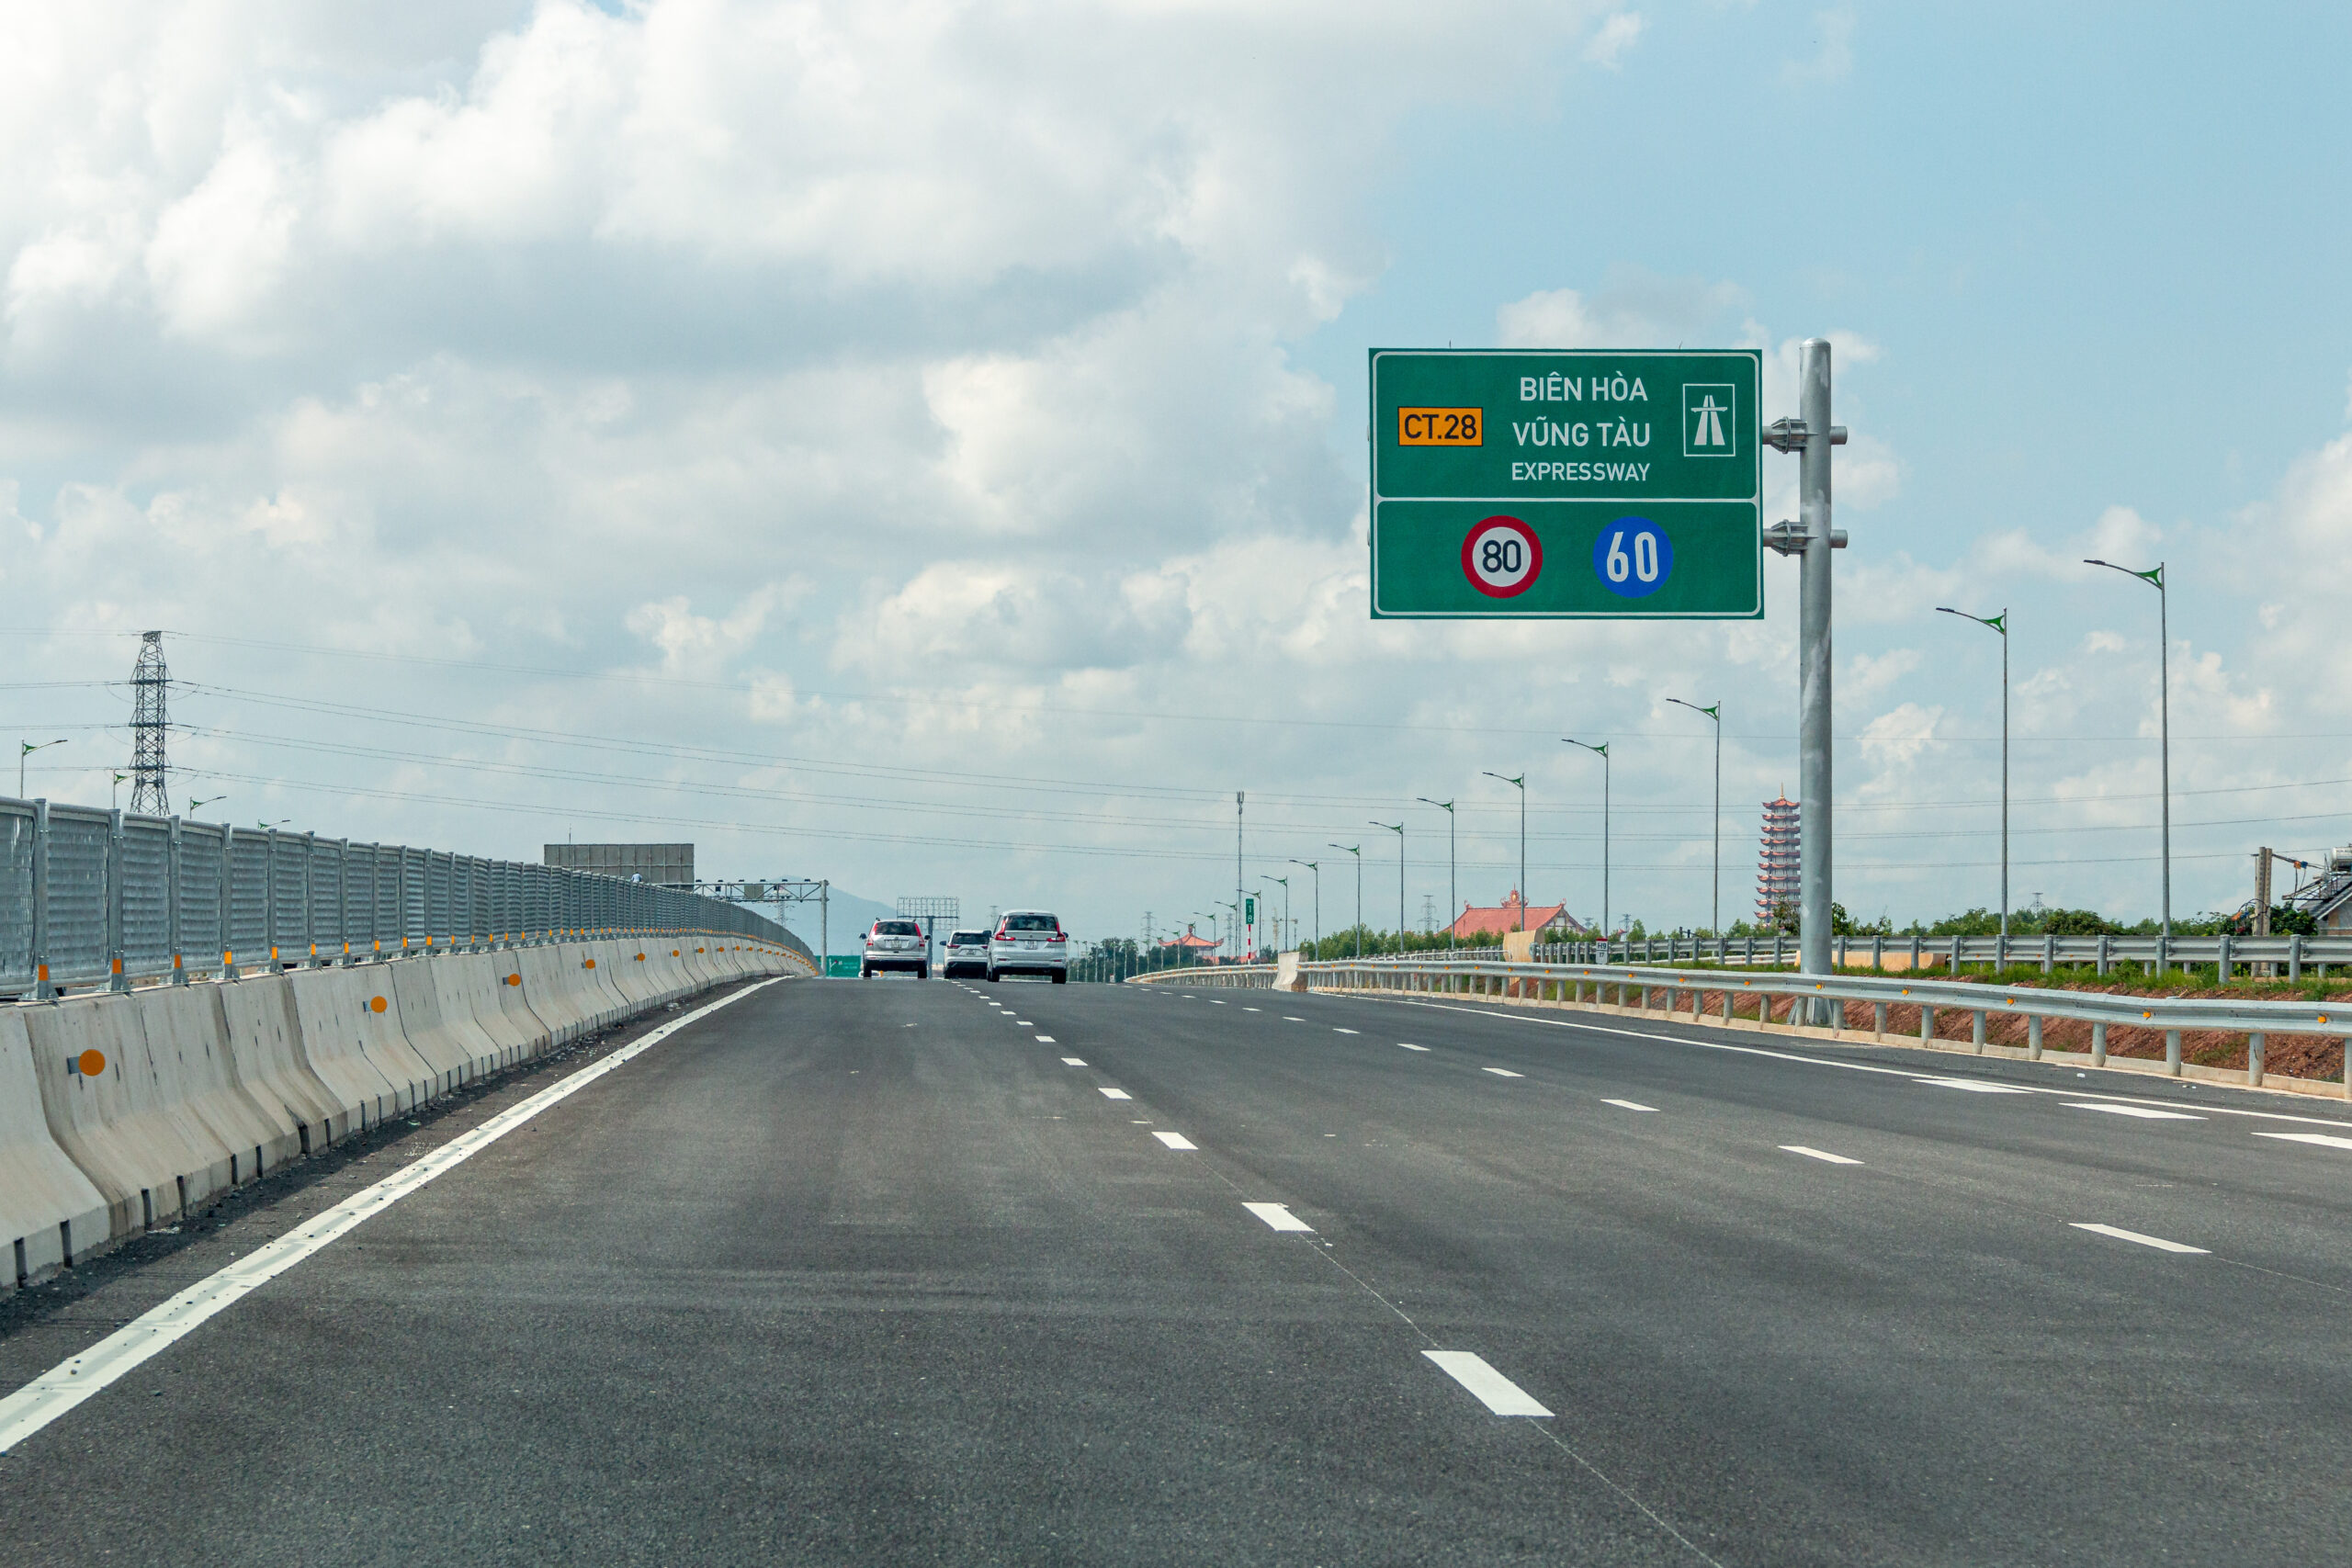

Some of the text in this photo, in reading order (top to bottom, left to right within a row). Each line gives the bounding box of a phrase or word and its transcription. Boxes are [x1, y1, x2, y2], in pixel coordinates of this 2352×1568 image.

[1521, 371, 1648, 401] BIÊN HÒA
[1404, 414, 1477, 440] CT.28
[1512, 416, 1650, 447] VŨNG TÀU
[1511, 462, 1650, 481] EXPRESSWAY
[1483, 539, 1521, 573] 80
[1607, 532, 1658, 582] 60
